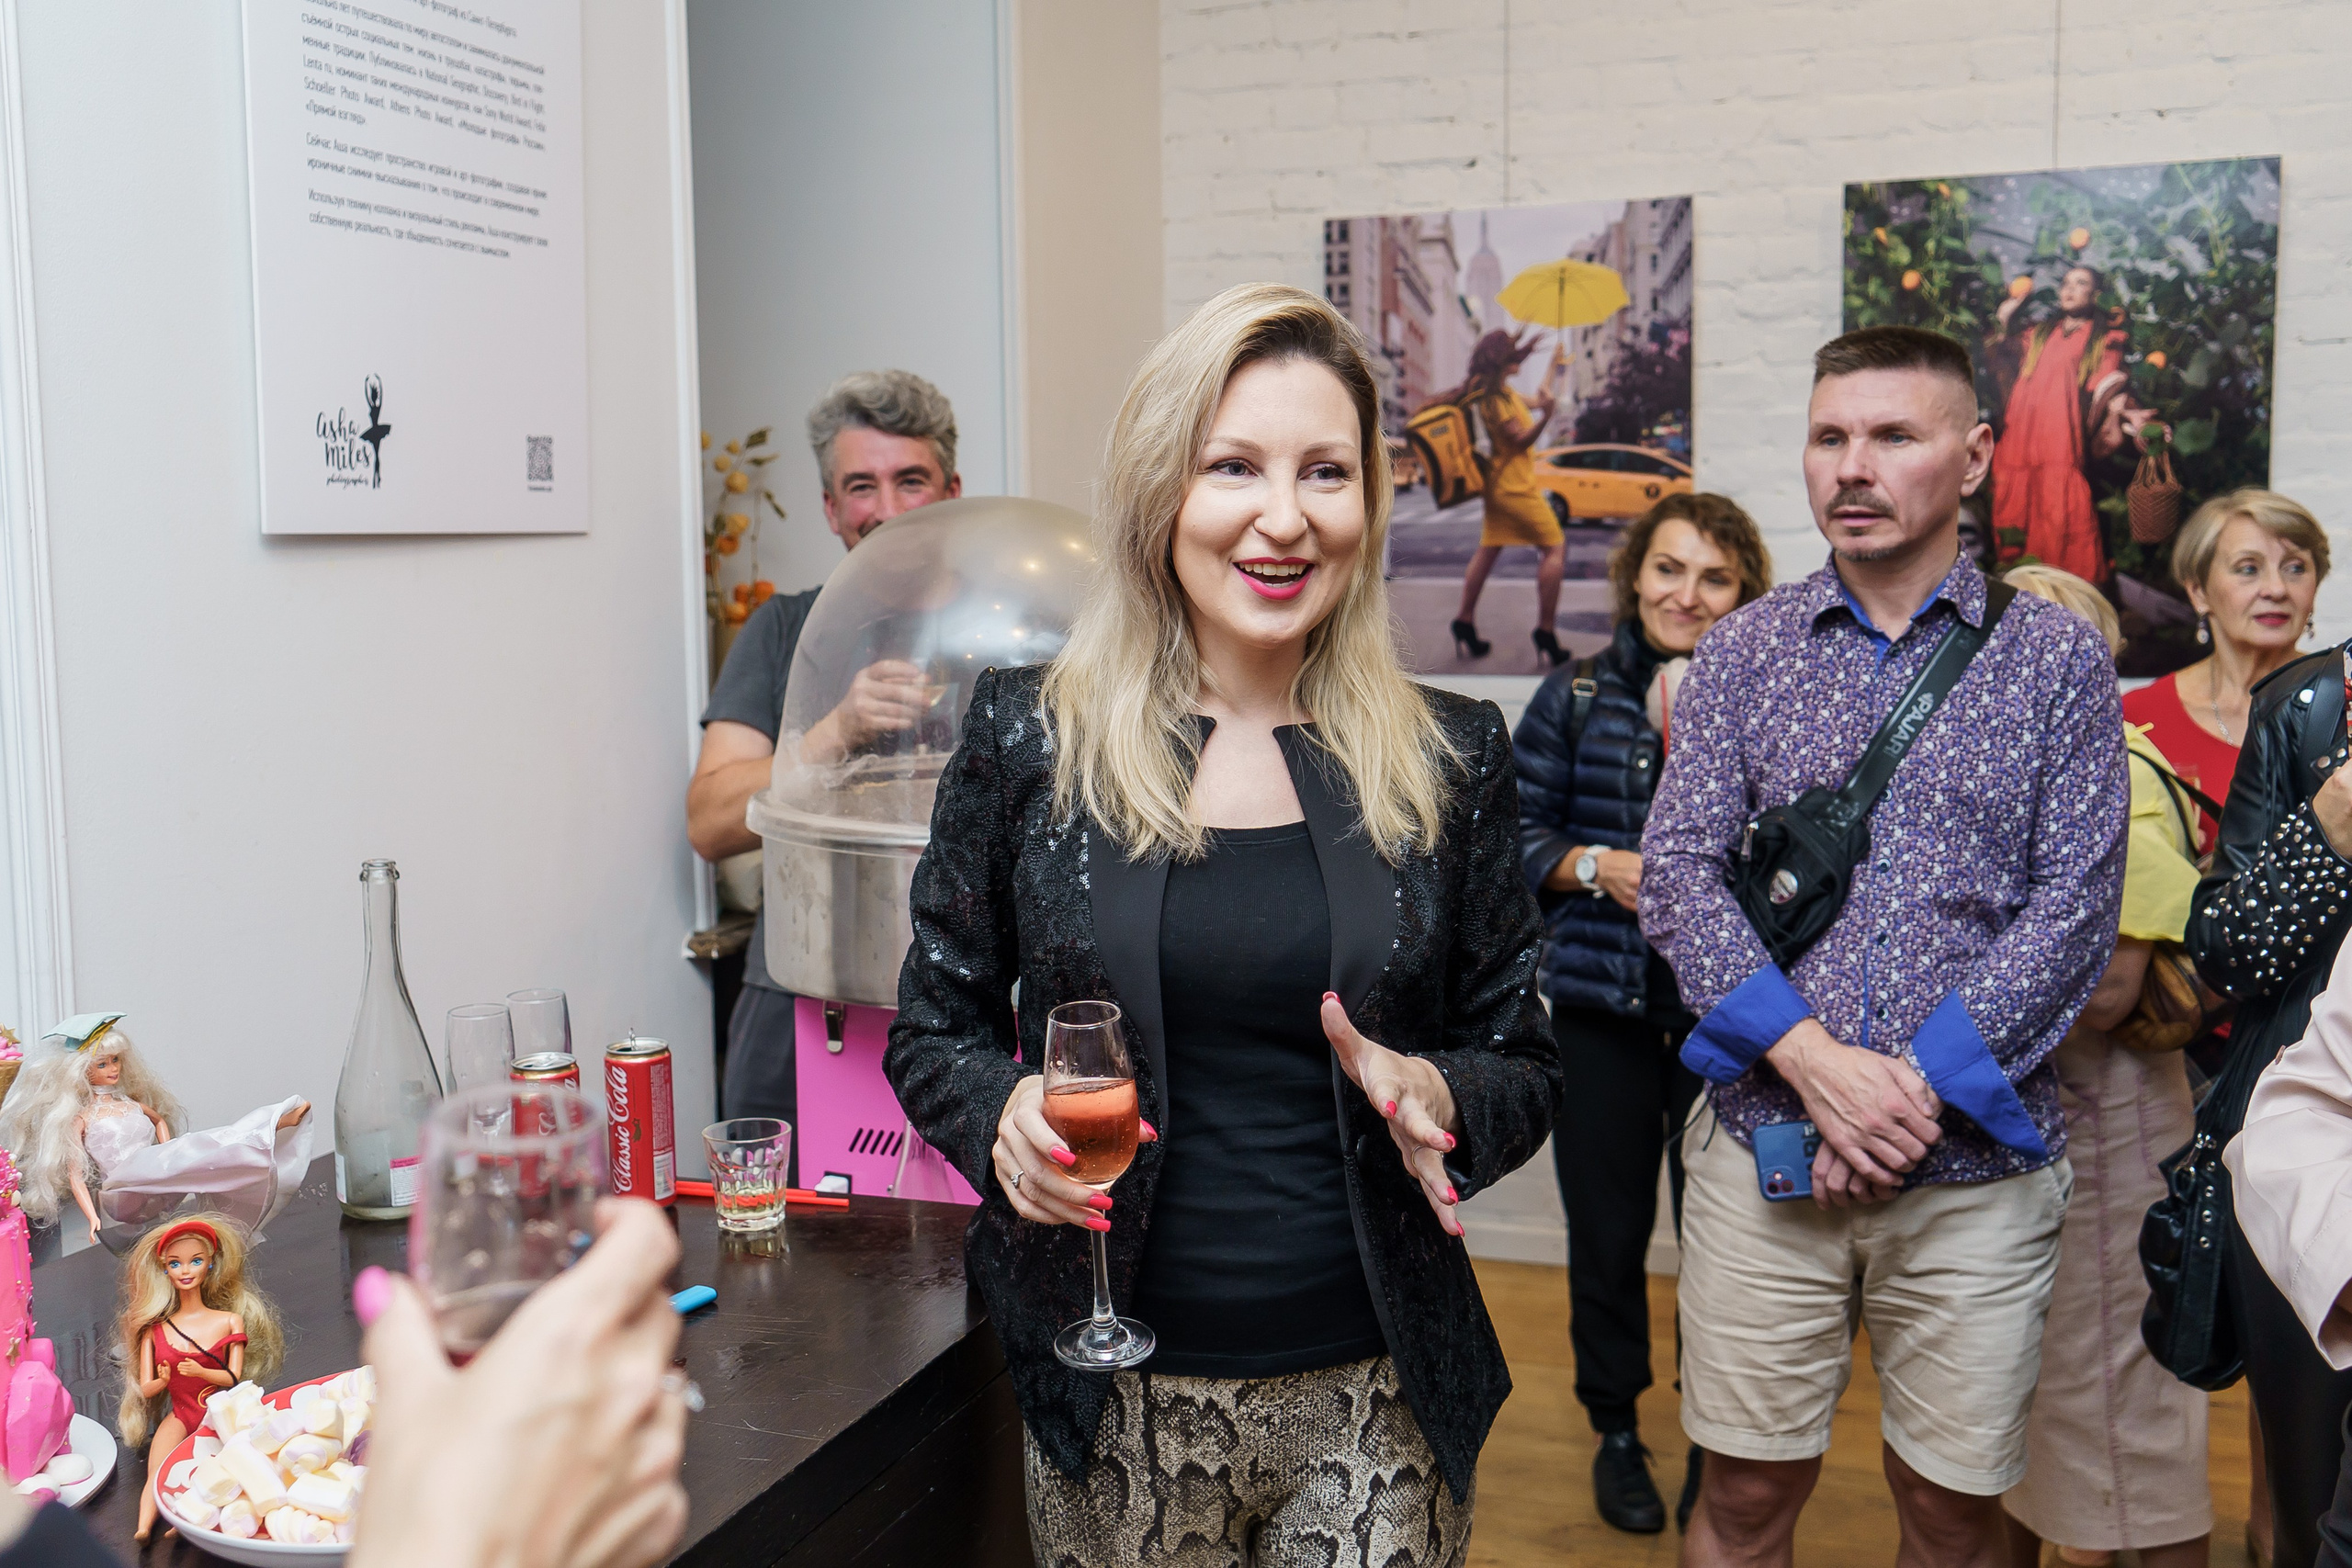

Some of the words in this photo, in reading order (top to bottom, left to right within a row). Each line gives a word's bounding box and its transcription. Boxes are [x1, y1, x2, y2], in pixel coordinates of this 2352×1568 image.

[335, 23, 358, 38] острых
[361, 30, 399, 50] социальных
[339, 3, 350, 13] лет
[352, 6, 403, 30] путешествовала
[414, 28, 428, 40] миру
[302, 36, 330, 51] менные
[334, 43, 367, 61] традиции.
[369, 51, 416, 75] Публиковалась
[425, 69, 447, 85] National
[304, 76, 335, 96] Schoeller
[340, 85, 360, 102] Photo
[390, 100, 411, 115] Athens
[414, 106, 431, 120] Photo
[306, 99, 336, 117] «Прямой
[335, 67, 368, 82] номинант
[370, 75, 387, 88] таких
[390, 82, 438, 102] международных
[484, 106, 496, 120] Sony
[499, 110, 513, 123] World
[306, 132, 332, 150] Сейчас
[334, 139, 348, 153] Аша
[350, 146, 384, 162] исследует
[385, 153, 426, 170] пространство
[429, 164, 451, 176] игровой
[308, 158, 345, 174] ироничные
[309, 188, 344, 208] Используя
[346, 198, 371, 213] технику
[373, 205, 400, 218] коллажа
[408, 211, 442, 225] визуальный
[310, 211, 353, 231] собственную
[605, 1065, 630, 1126] Cola
[612, 1125, 633, 1194] Classic
